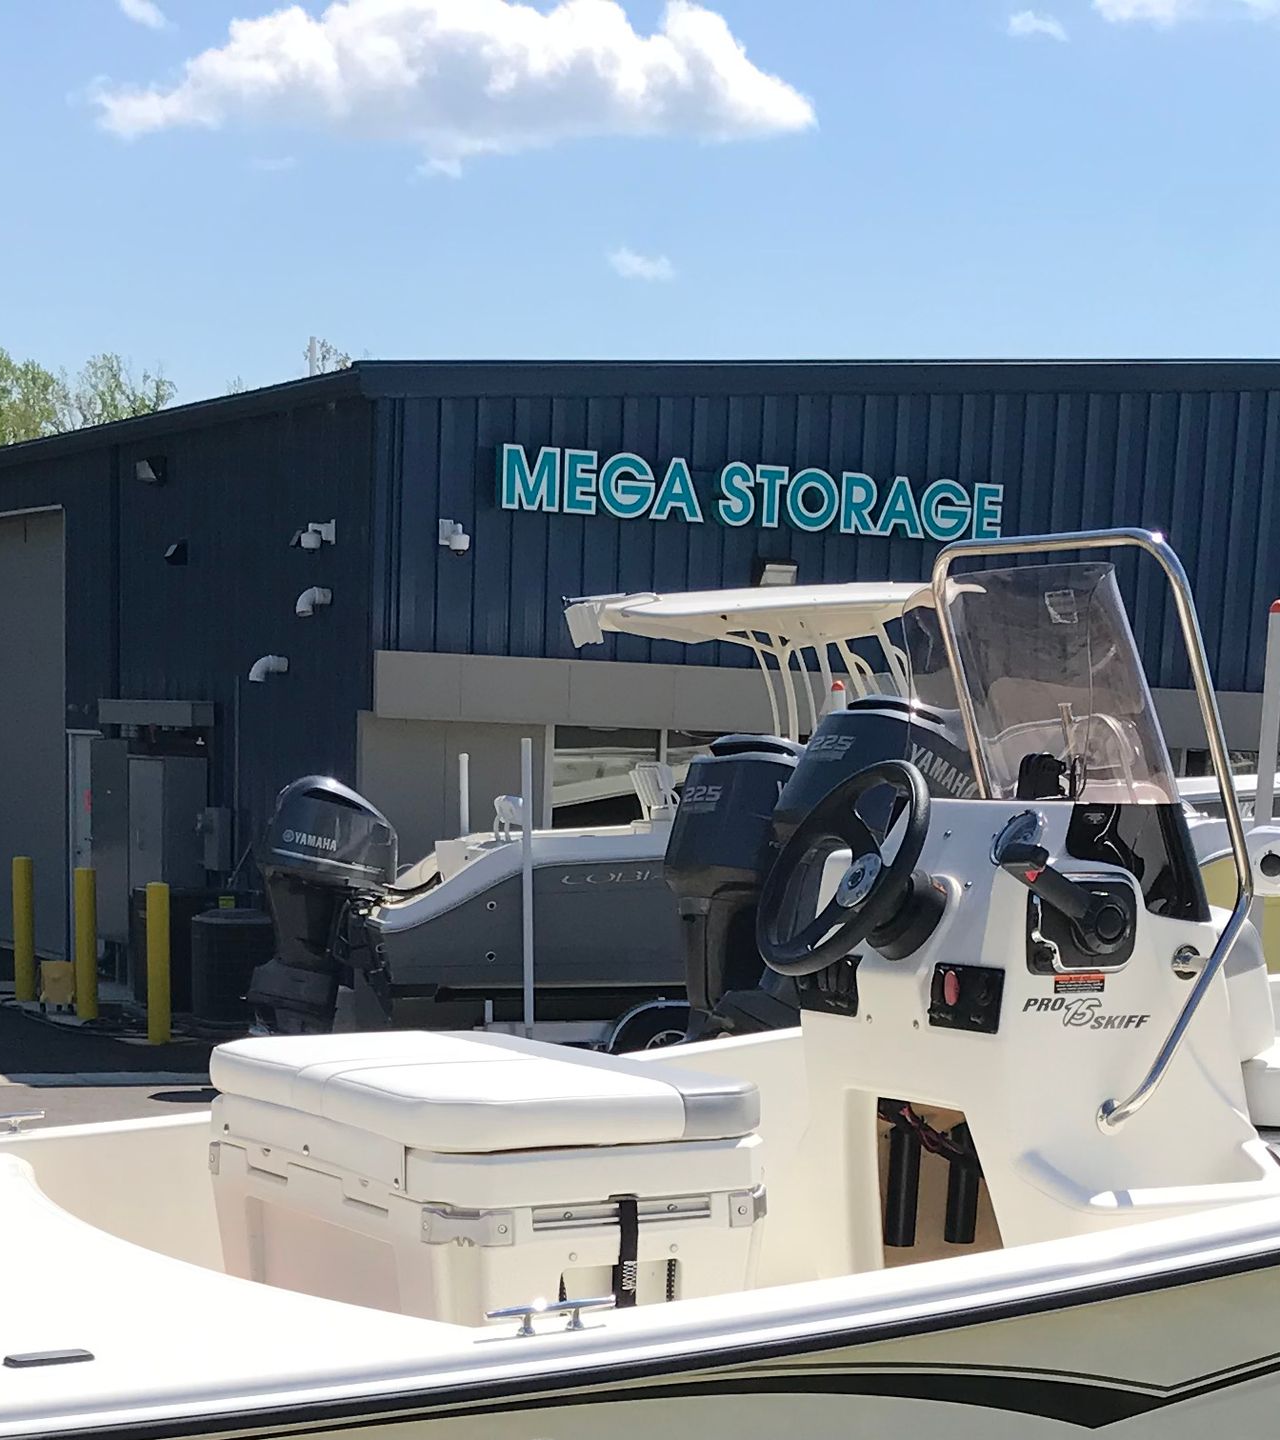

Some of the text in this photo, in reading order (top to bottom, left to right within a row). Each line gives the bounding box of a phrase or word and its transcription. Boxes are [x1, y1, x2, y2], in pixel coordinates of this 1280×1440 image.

[502, 444, 1004, 542] MEGA STORAGE
[810, 734, 856, 751] 225
[683, 785, 722, 803] 225
[295, 831, 337, 851] YAMAHA
[1022, 997, 1151, 1030] PRO 15 SKIFF
